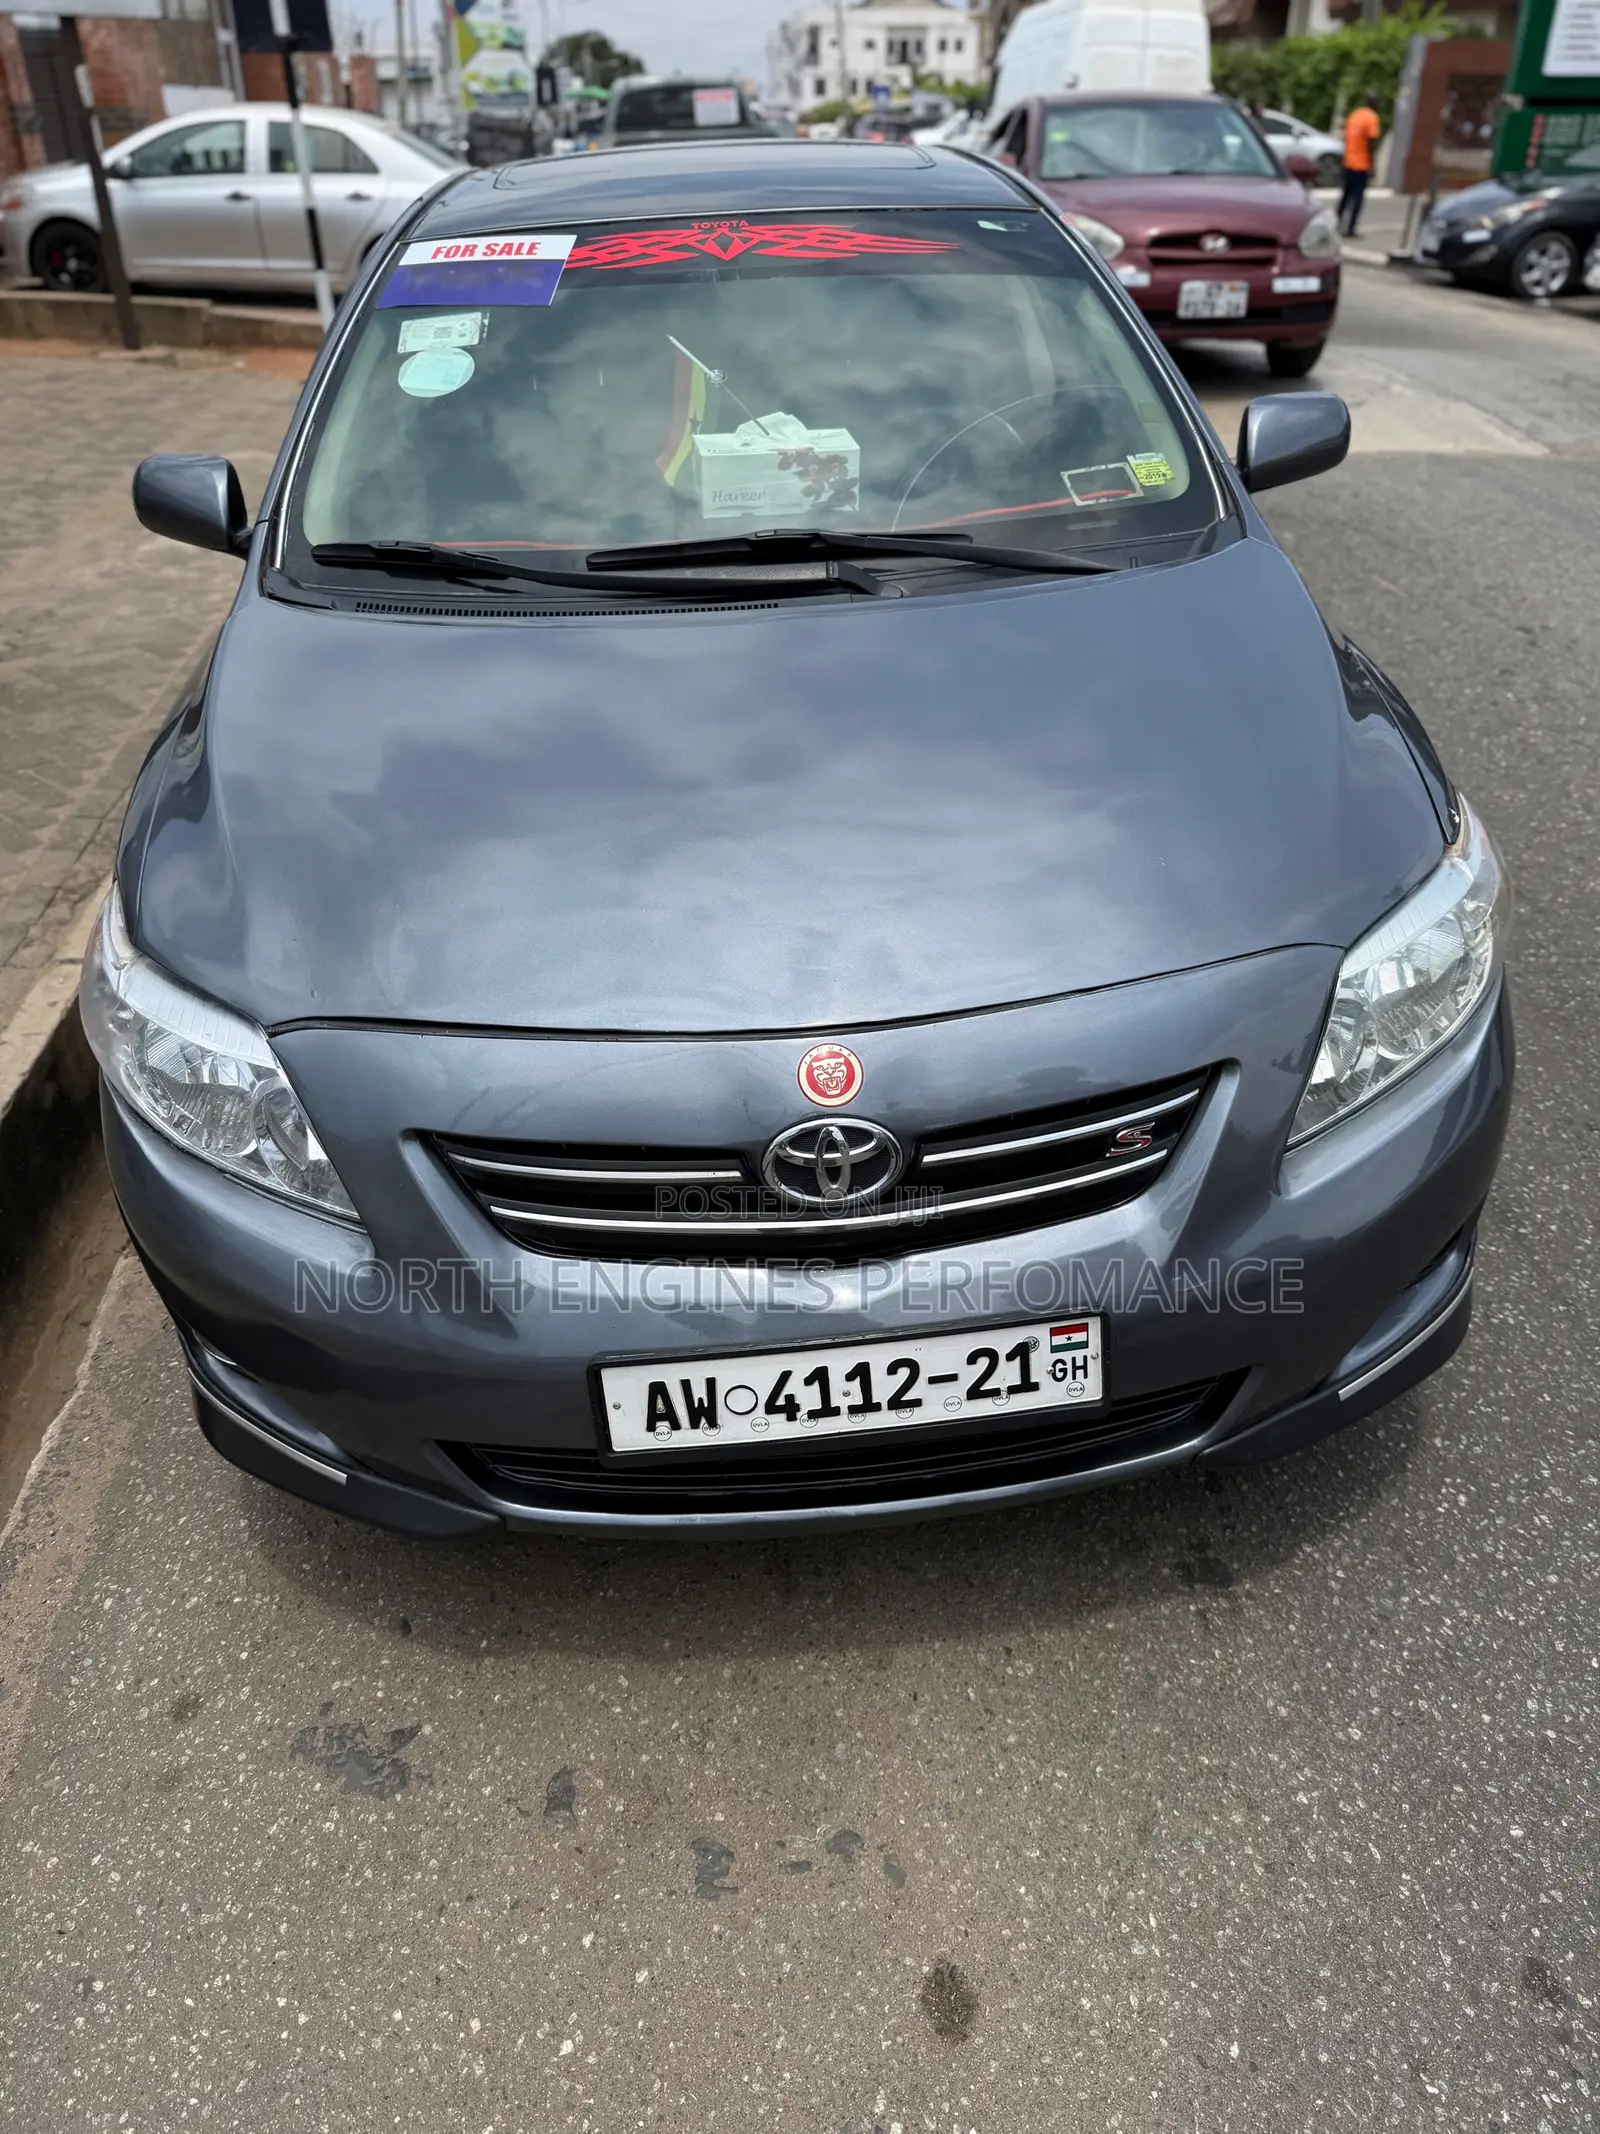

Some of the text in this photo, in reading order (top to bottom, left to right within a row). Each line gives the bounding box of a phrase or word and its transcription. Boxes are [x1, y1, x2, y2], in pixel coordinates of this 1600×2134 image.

[691, 220, 749, 230] TOYOTA
[431, 241, 542, 260] FOR SALE
[803, 1045, 852, 1065] JAGUAR
[1051, 1355, 1088, 1382] GH
[646, 1341, 1040, 1433] AW 4112-21
